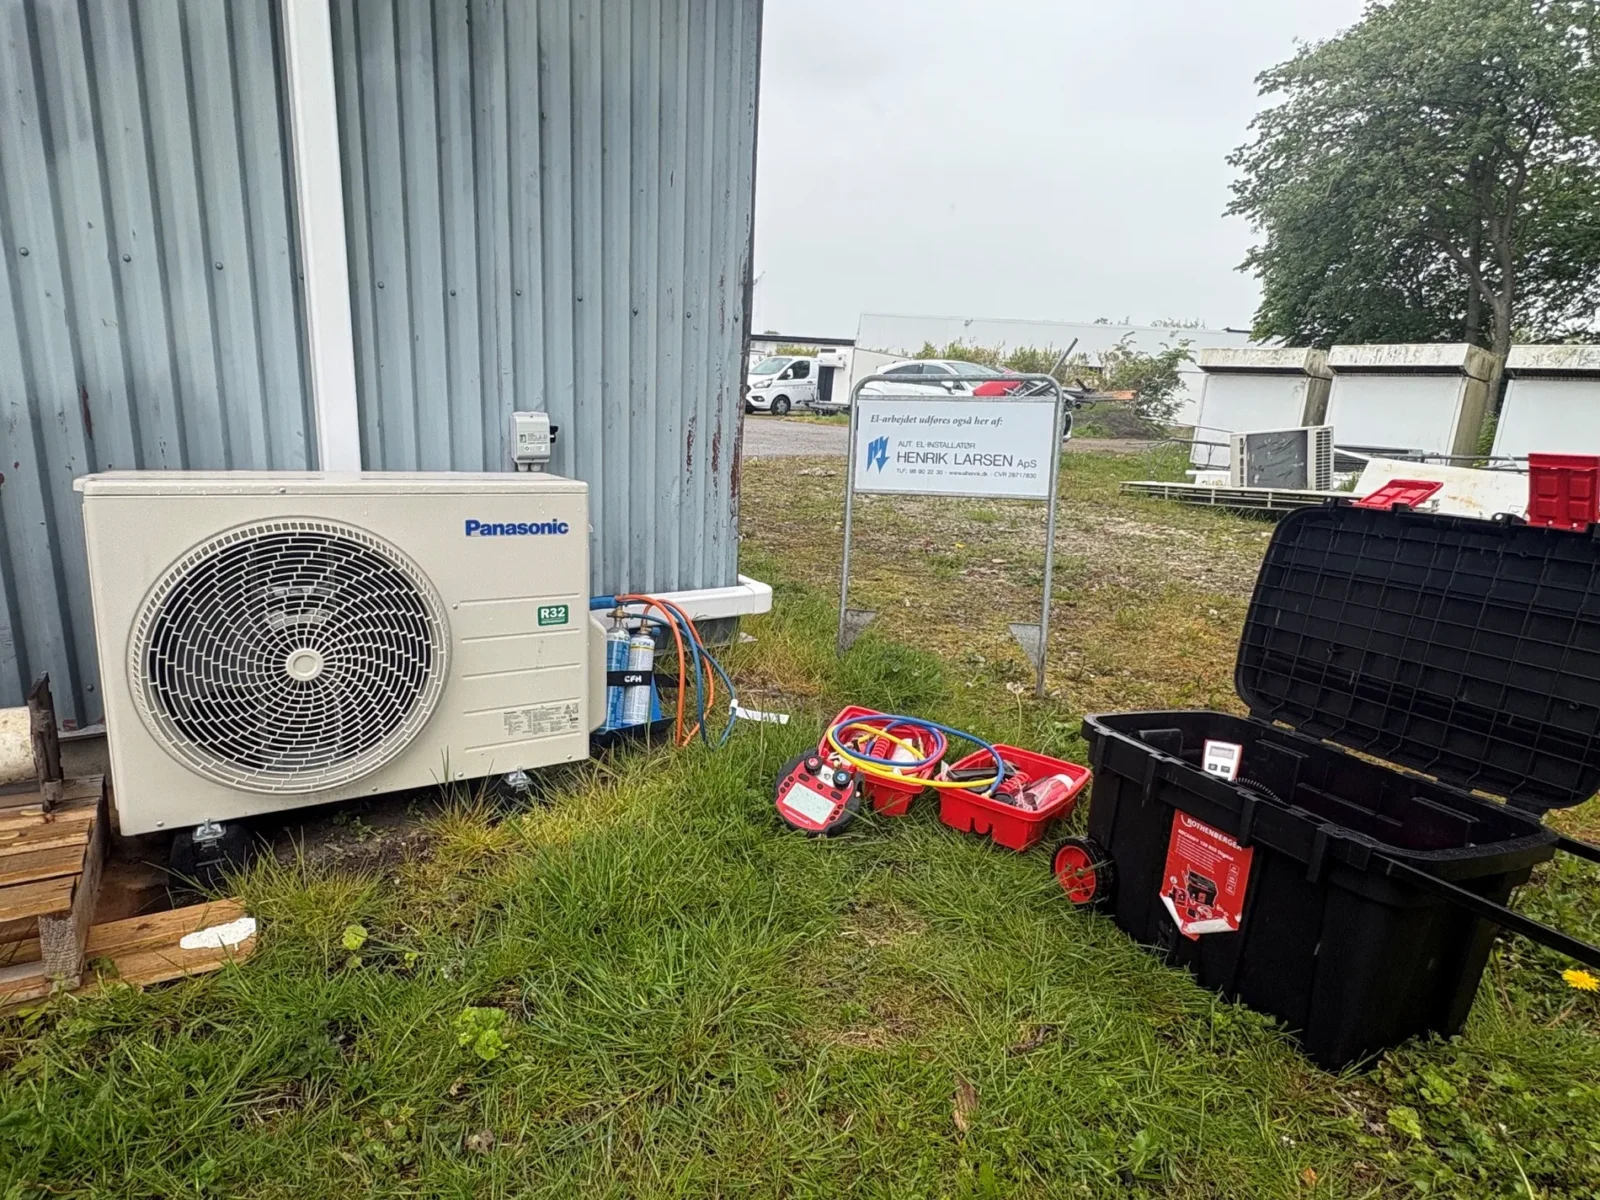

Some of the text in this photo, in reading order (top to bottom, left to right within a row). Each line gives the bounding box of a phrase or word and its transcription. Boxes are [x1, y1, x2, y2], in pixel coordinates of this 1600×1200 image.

[870, 414, 1003, 428] El-arbejdet udføres også her af:
[897, 440, 914, 448] AUT.
[896, 451, 1037, 469] HENRIK LARSEN ApS
[465, 518, 569, 537] Panasonic
[540, 606, 566, 619] R32
[624, 675, 642, 683] CFH
